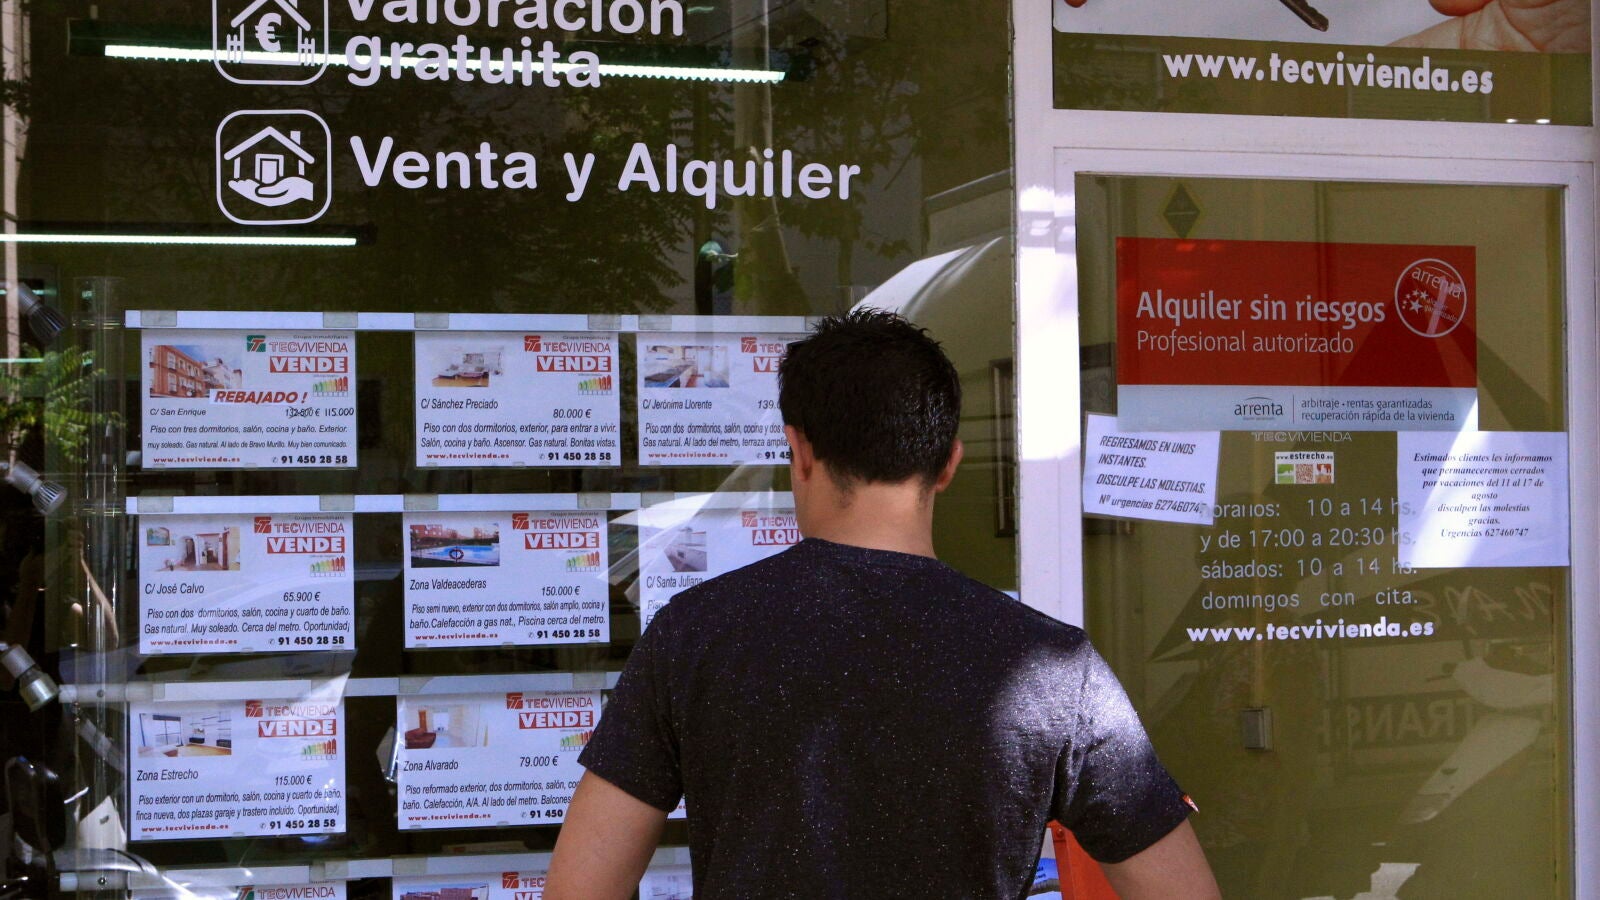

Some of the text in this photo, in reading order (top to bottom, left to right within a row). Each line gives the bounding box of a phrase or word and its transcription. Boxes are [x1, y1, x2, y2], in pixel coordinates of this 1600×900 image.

[345, 34, 600, 88] gratuita
[1163, 51, 1493, 95] www.tecvivienda.es
[350, 136, 860, 210] Venta y Alquiler
[1136, 290, 1242, 327] Alquiler
[1250, 294, 1288, 321] sin
[1295, 295, 1385, 329] riesgos
[269, 341, 348, 353] TECVIVIENDA
[543, 342, 611, 353] TECVIVIENDA
[1137, 330, 1354, 356] Profesional autorizado
[270, 356, 348, 373] VENDE
[537, 356, 611, 372] VENDE
[214, 390, 308, 404] REBAJADO !
[420, 398, 499, 409] C/ Sánchez Preciado
[685, 400, 712, 410] Llorente
[1234, 401, 1284, 416] arrenta
[1301, 399, 1433, 411] arbitraje rentas garantizadas
[160, 408, 176, 416] San
[177, 408, 206, 417] Enrique
[553, 409, 592, 419] 80.000 €
[1301, 410, 1455, 421] recuperación rápida de la vivienda
[1251, 431, 1352, 442] TECVIVIENDA
[1100, 436, 1196, 455] REGRESAMOS EN UNOS
[281, 455, 348, 464] 91 450 28 58
[548, 452, 612, 461] 91 450 28 58
[764, 451, 776, 460] 91
[1098, 454, 1147, 468] INSTANTES.
[1413, 453, 1553, 463] Estimados clientes les informamos
[1421, 466, 1545, 476] que permaneceremos cerrados
[1096, 474, 1206, 494] DISCULPE LAS MOLESTIAS.
[1422, 478, 1544, 489] por vacaciones del 11 al 17 de
[1471, 491, 1498, 500] agosto
[1111, 497, 1154, 509] urgencias
[1308, 498, 1333, 516] 10
[1340, 503, 1350, 516] a
[1360, 498, 1383, 515] 14
[1438, 504, 1530, 513] disculpen las molestias
[274, 522, 345, 534] TECVIVIENDA
[531, 518, 599, 530] TECVIVIENDA
[1440, 528, 1529, 538] Urgencias 627460747
[267, 537, 345, 554] VENDE
[525, 533, 599, 550] VENDE
[1200, 535, 1212, 553] y
[1218, 530, 1241, 548] de
[1249, 529, 1304, 547] 17:00
[1312, 533, 1322, 546] a
[1329, 527, 1385, 546] 20:30
[1201, 556, 1417, 579] sábados: 10 a 14 hs.
[410, 578, 487, 590] Zona Valdeacederas
[656, 576, 677, 588] Santa
[145, 583, 204, 594] C/ José Calvo
[541, 585, 581, 596] 150.000 €
[283, 591, 321, 601] 65.900 €
[1202, 591, 1300, 613] domingos
[1320, 592, 1355, 606] con
[1375, 587, 1418, 605] cita.
[536, 629, 600, 639] 91 450 28 58
[1186, 616, 1434, 642] www.tecvivienda.es
[278, 635, 345, 646] 91 450 28 58
[525, 697, 593, 709] TECVIVIENDA
[266, 704, 337, 717] TECVIVIENDA
[519, 711, 593, 729] VENDE
[259, 719, 336, 737] VENDE
[403, 759, 459, 772] Zona Alvarado
[519, 756, 559, 767] 79.000 €
[137, 769, 198, 781] Zona Estrecho
[275, 775, 313, 786] 115.000 €
[408, 812, 491, 821] www.tecvivienda.es
[530, 809, 563, 819] 91 450
[269, 819, 336, 830] 91 450 28 58
[258, 887, 335, 899] TECVIVIENDA
